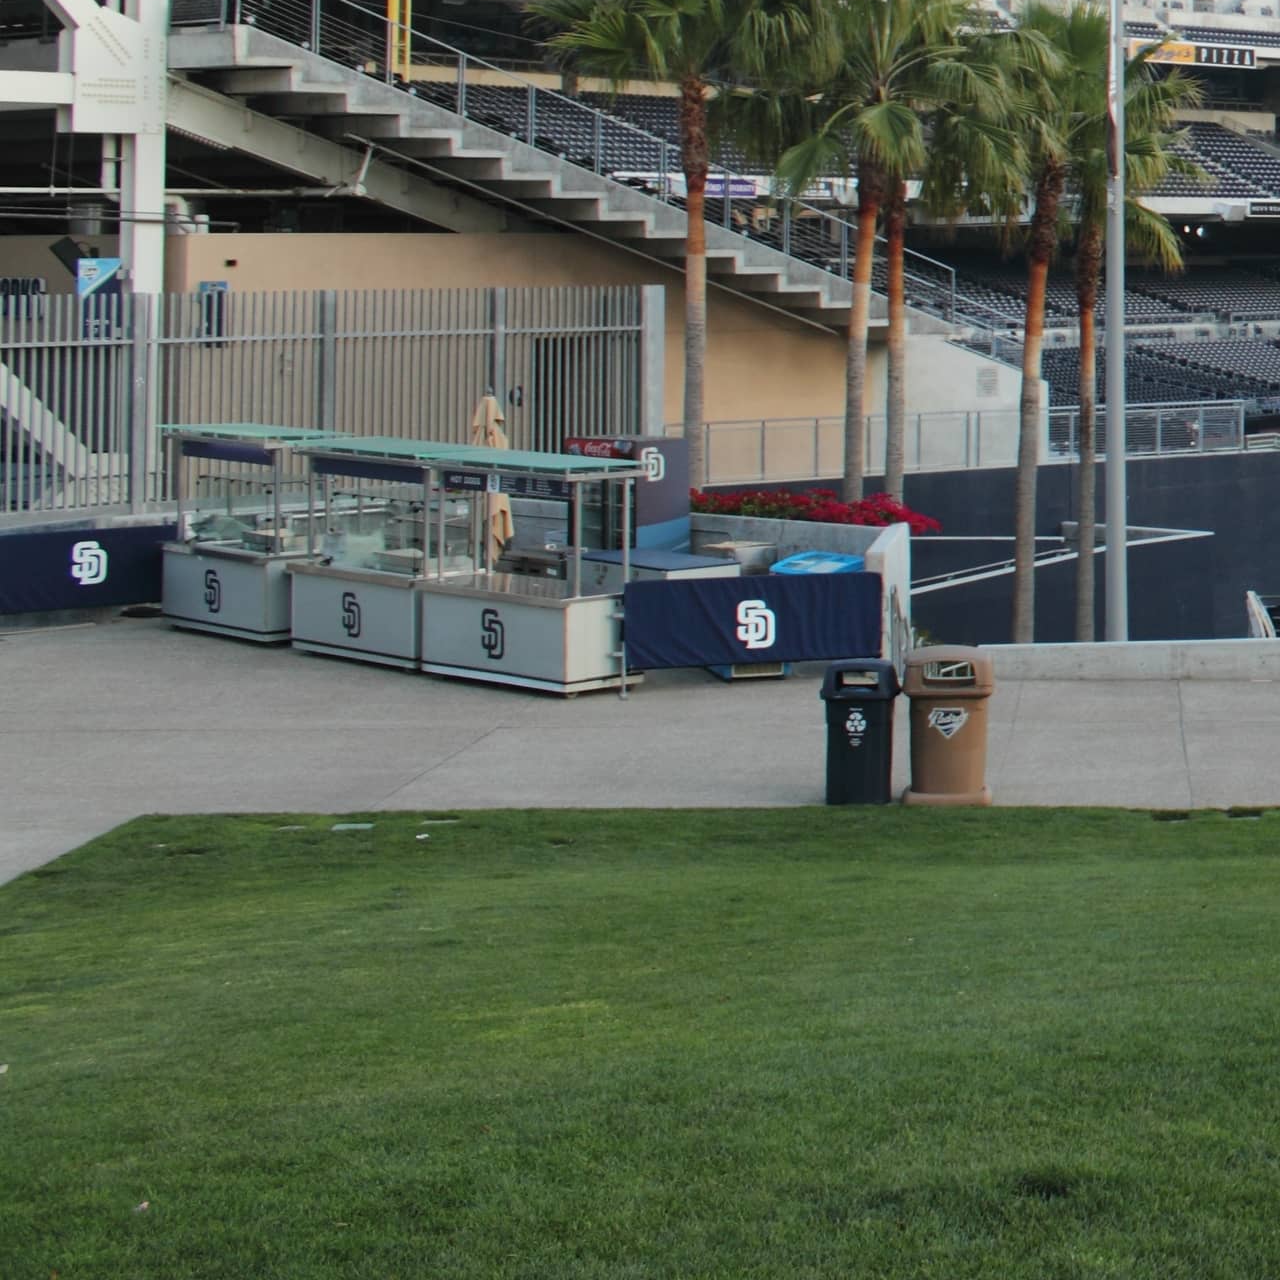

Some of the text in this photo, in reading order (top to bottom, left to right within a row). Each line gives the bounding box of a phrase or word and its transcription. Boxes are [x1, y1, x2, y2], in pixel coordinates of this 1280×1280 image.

[1201, 48, 1251, 65] PIZZA
[72, 540, 108, 585] SD
[481, 608, 505, 660] SD
[736, 599, 776, 649] SD
